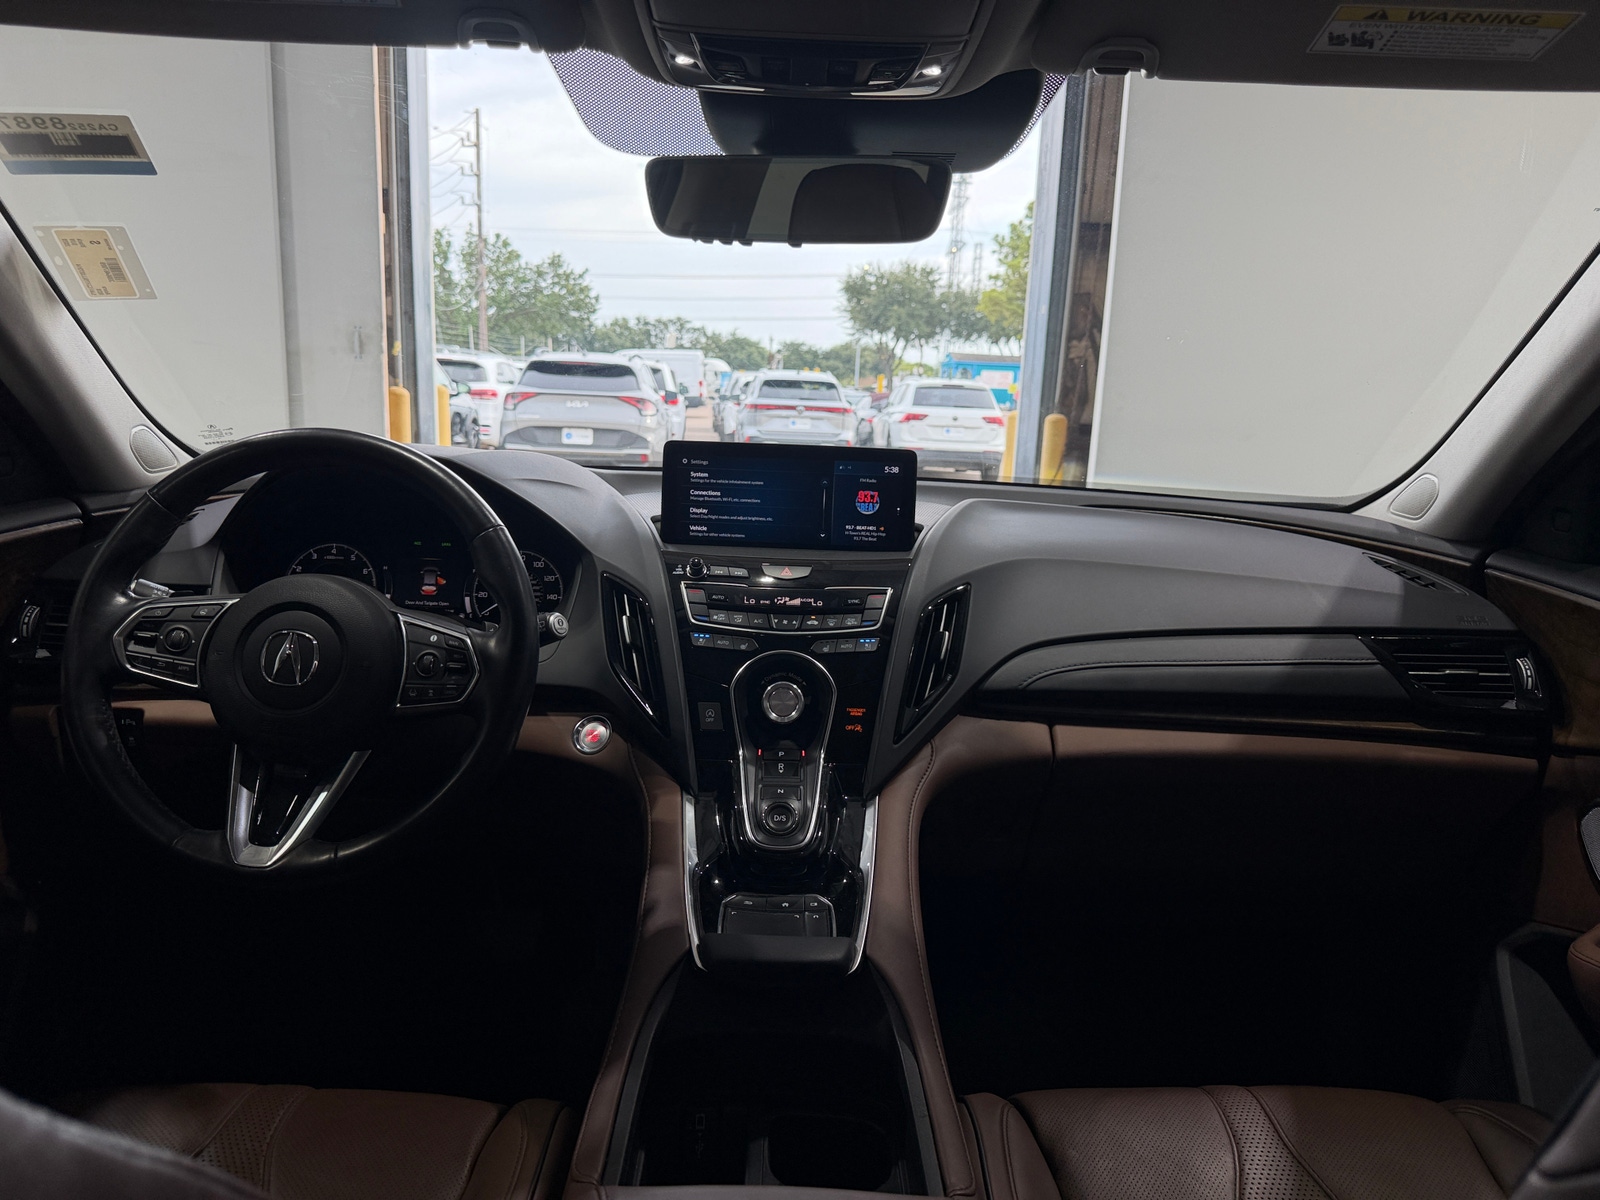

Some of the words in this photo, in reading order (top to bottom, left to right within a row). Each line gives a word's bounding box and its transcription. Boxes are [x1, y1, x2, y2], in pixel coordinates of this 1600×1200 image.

[1407, 10, 1541, 26] WARNING
[884, 466, 900, 474] 5:38
[858, 490, 879, 503] 93.7
